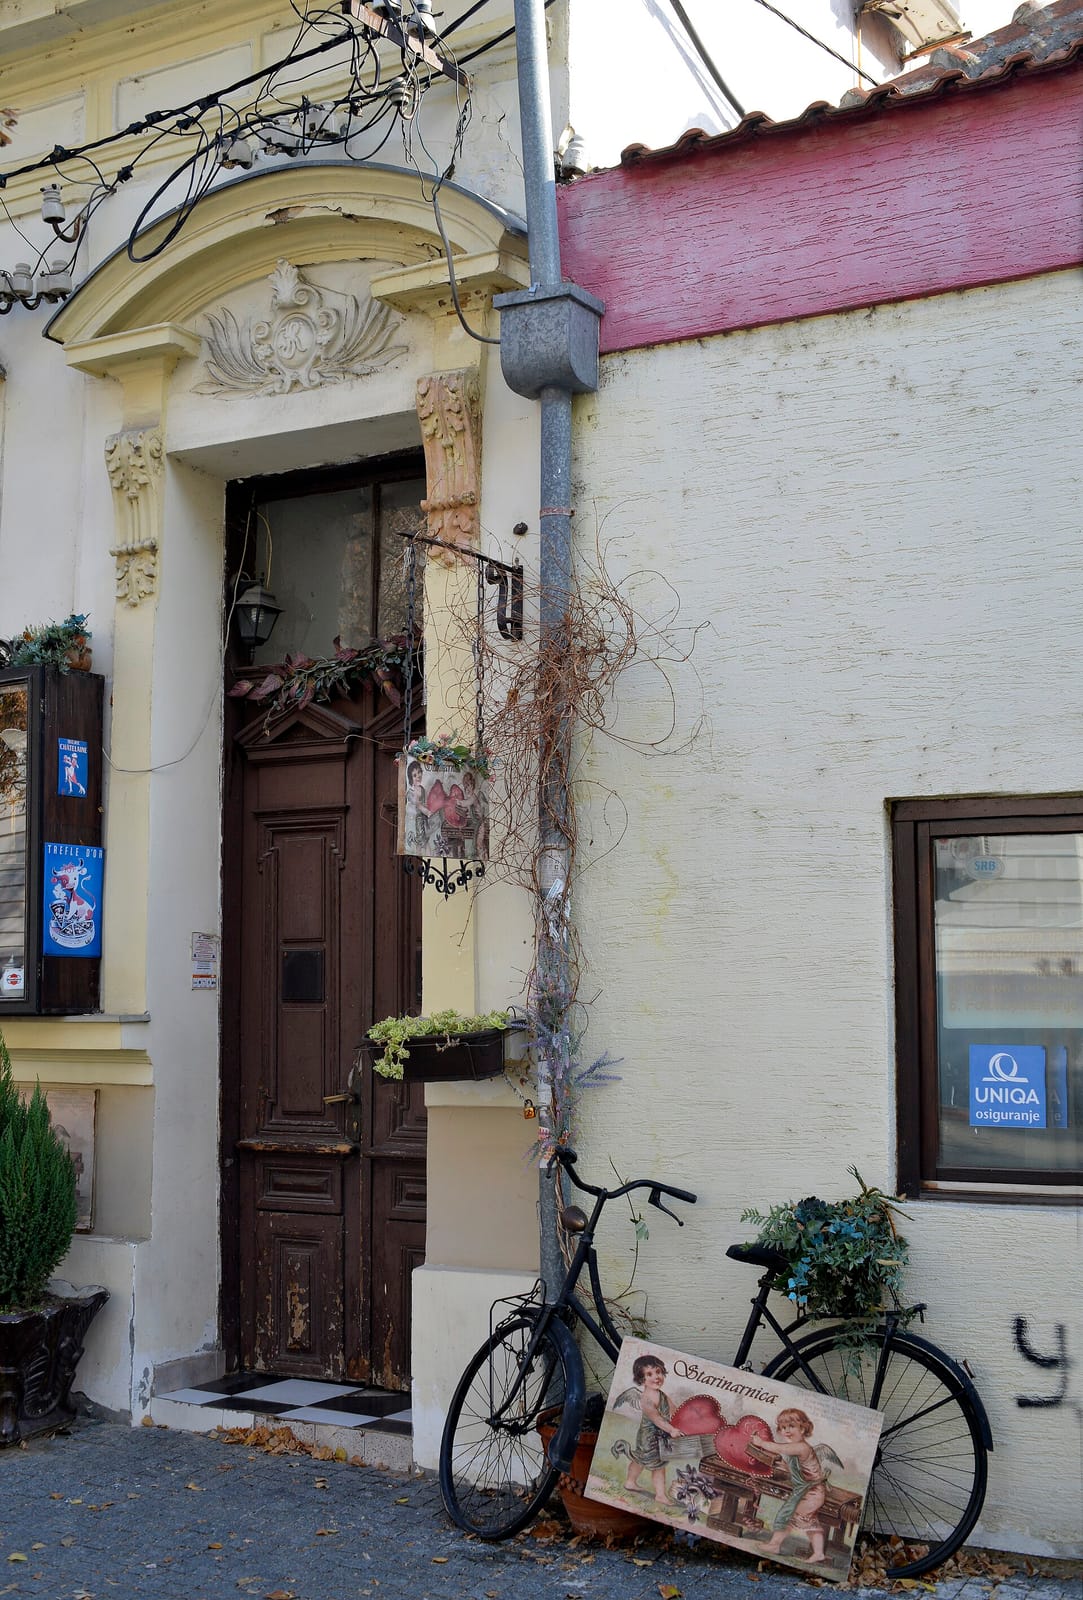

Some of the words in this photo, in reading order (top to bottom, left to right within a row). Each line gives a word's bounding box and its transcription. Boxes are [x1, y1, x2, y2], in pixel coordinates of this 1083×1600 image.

[974, 860, 996, 871] SRB
[975, 1087, 1040, 1105] UNIQA
[975, 1108, 1040, 1124] osiguranje
[673, 1359, 779, 1404] Starinarnica
